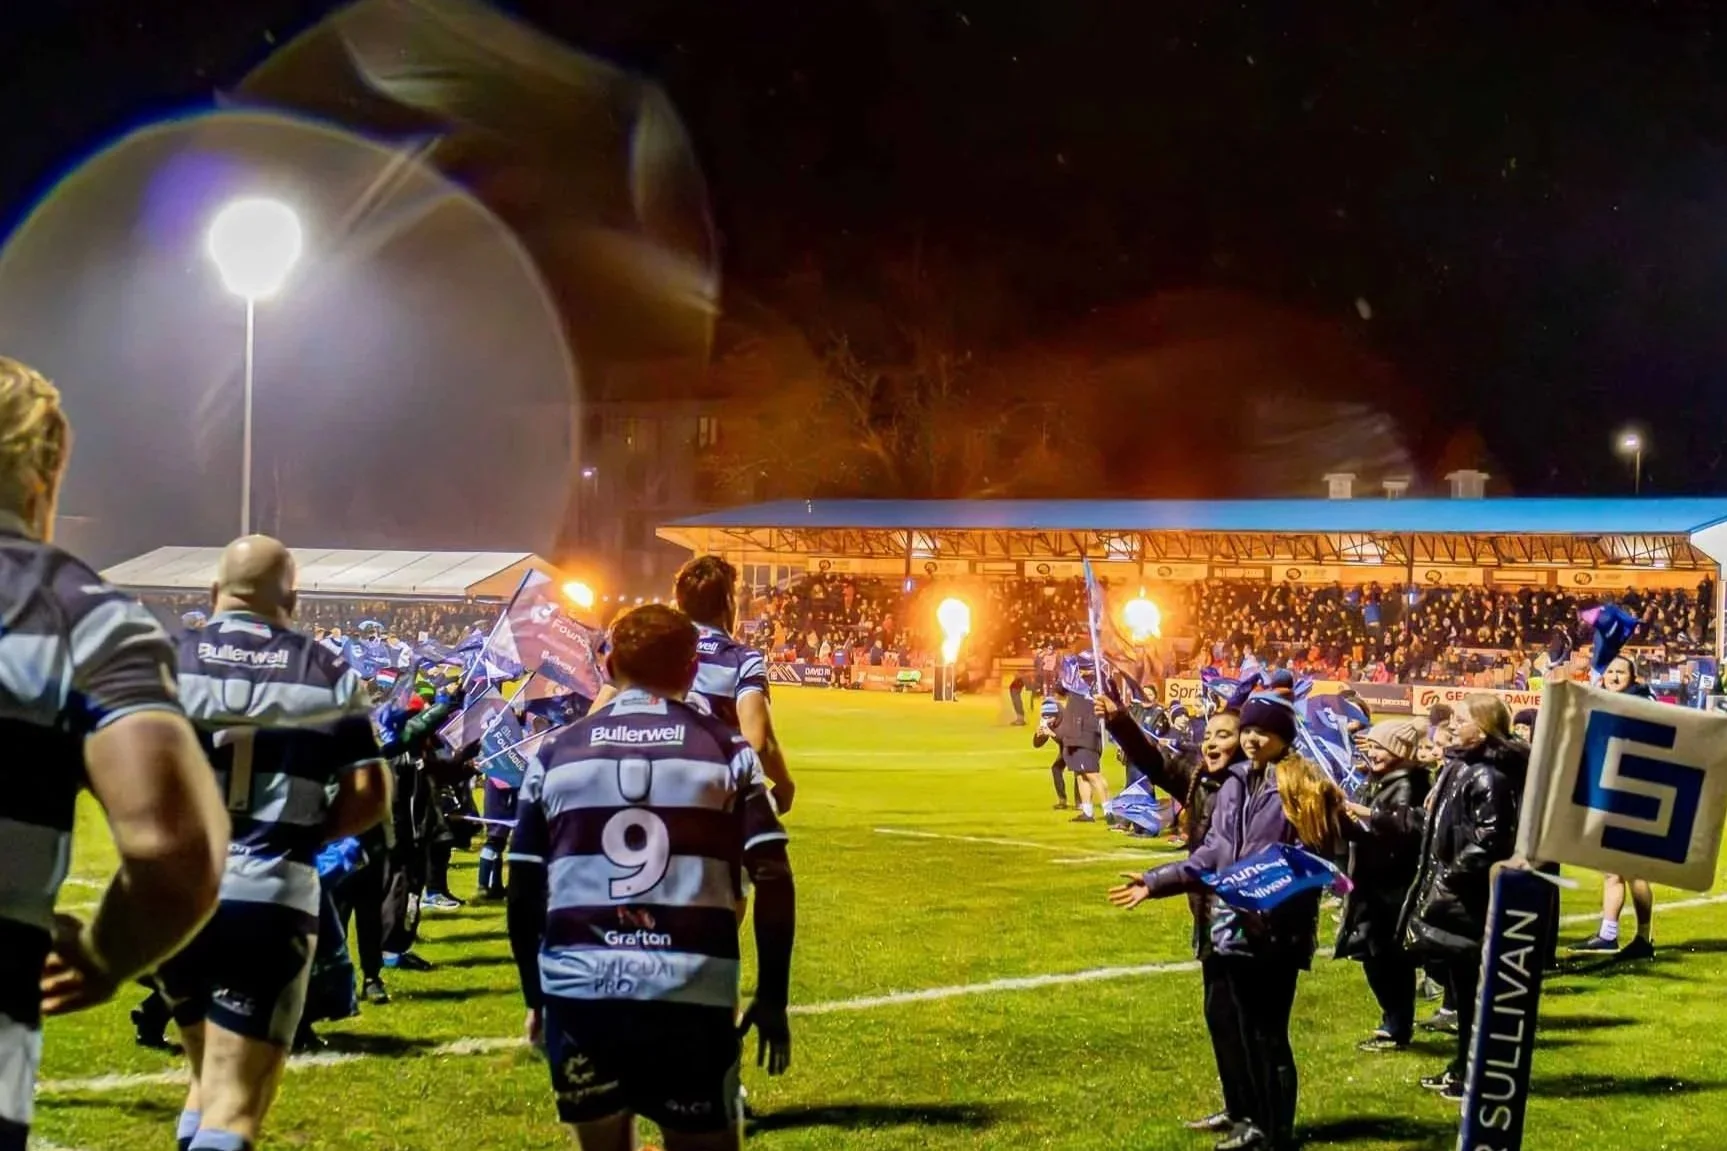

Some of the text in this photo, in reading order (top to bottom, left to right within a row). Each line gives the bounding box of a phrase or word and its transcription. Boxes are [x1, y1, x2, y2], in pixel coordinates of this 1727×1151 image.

[198, 642, 289, 665] Bullerwell
[1169, 683, 1201, 700] Spri
[1505, 694, 1541, 706] DAVIE
[590, 724, 685, 742] Bullerwell
[601, 807, 670, 899] 9
[604, 929, 672, 946] Grafton
[1479, 909, 1539, 1131] SULLIVAN
